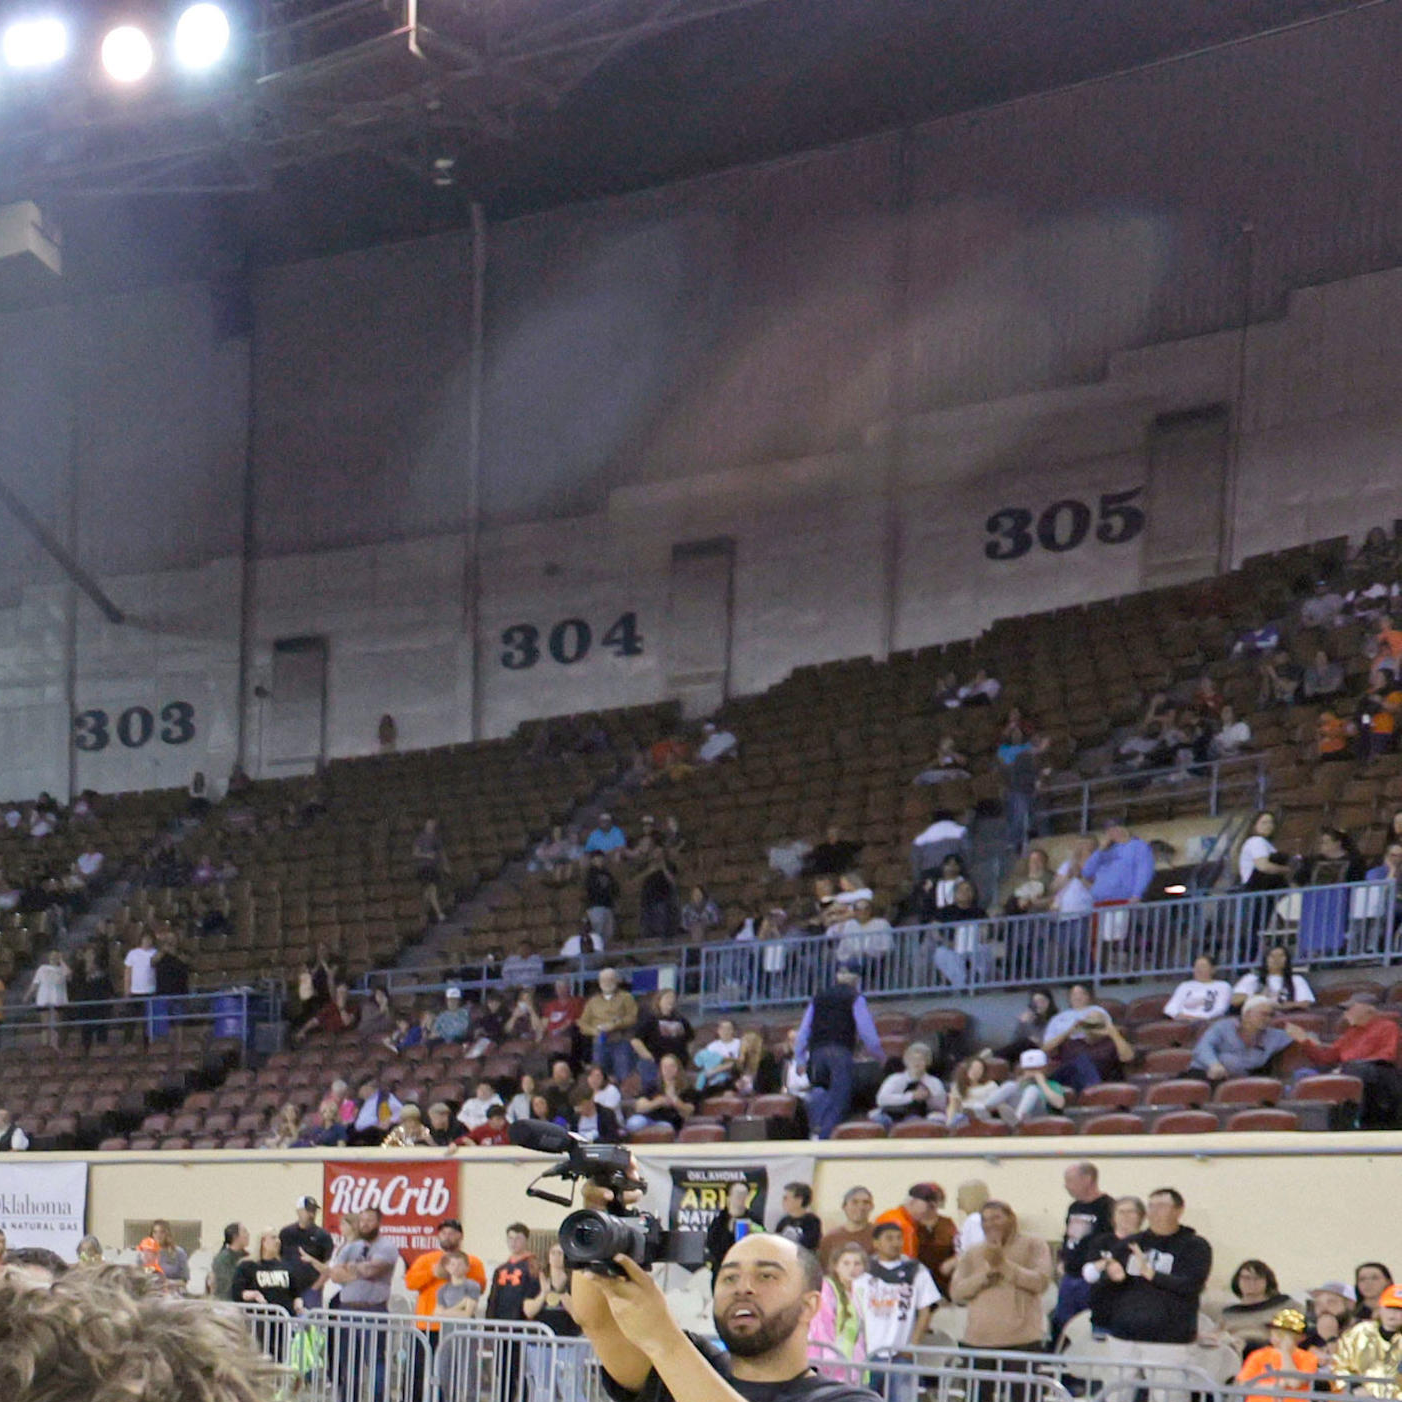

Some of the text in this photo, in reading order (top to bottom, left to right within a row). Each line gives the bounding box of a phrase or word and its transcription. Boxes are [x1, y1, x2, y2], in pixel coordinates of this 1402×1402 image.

[984, 486, 1146, 560] 305
[499, 612, 644, 670] 304
[73, 701, 196, 752] 303
[329, 1175, 451, 1217] RibCrib
[680, 1182, 758, 1211] ARY
[686, 1169, 747, 1182] OKLAHOMA
[10, 1222, 79, 1231] NATURAL GAS
